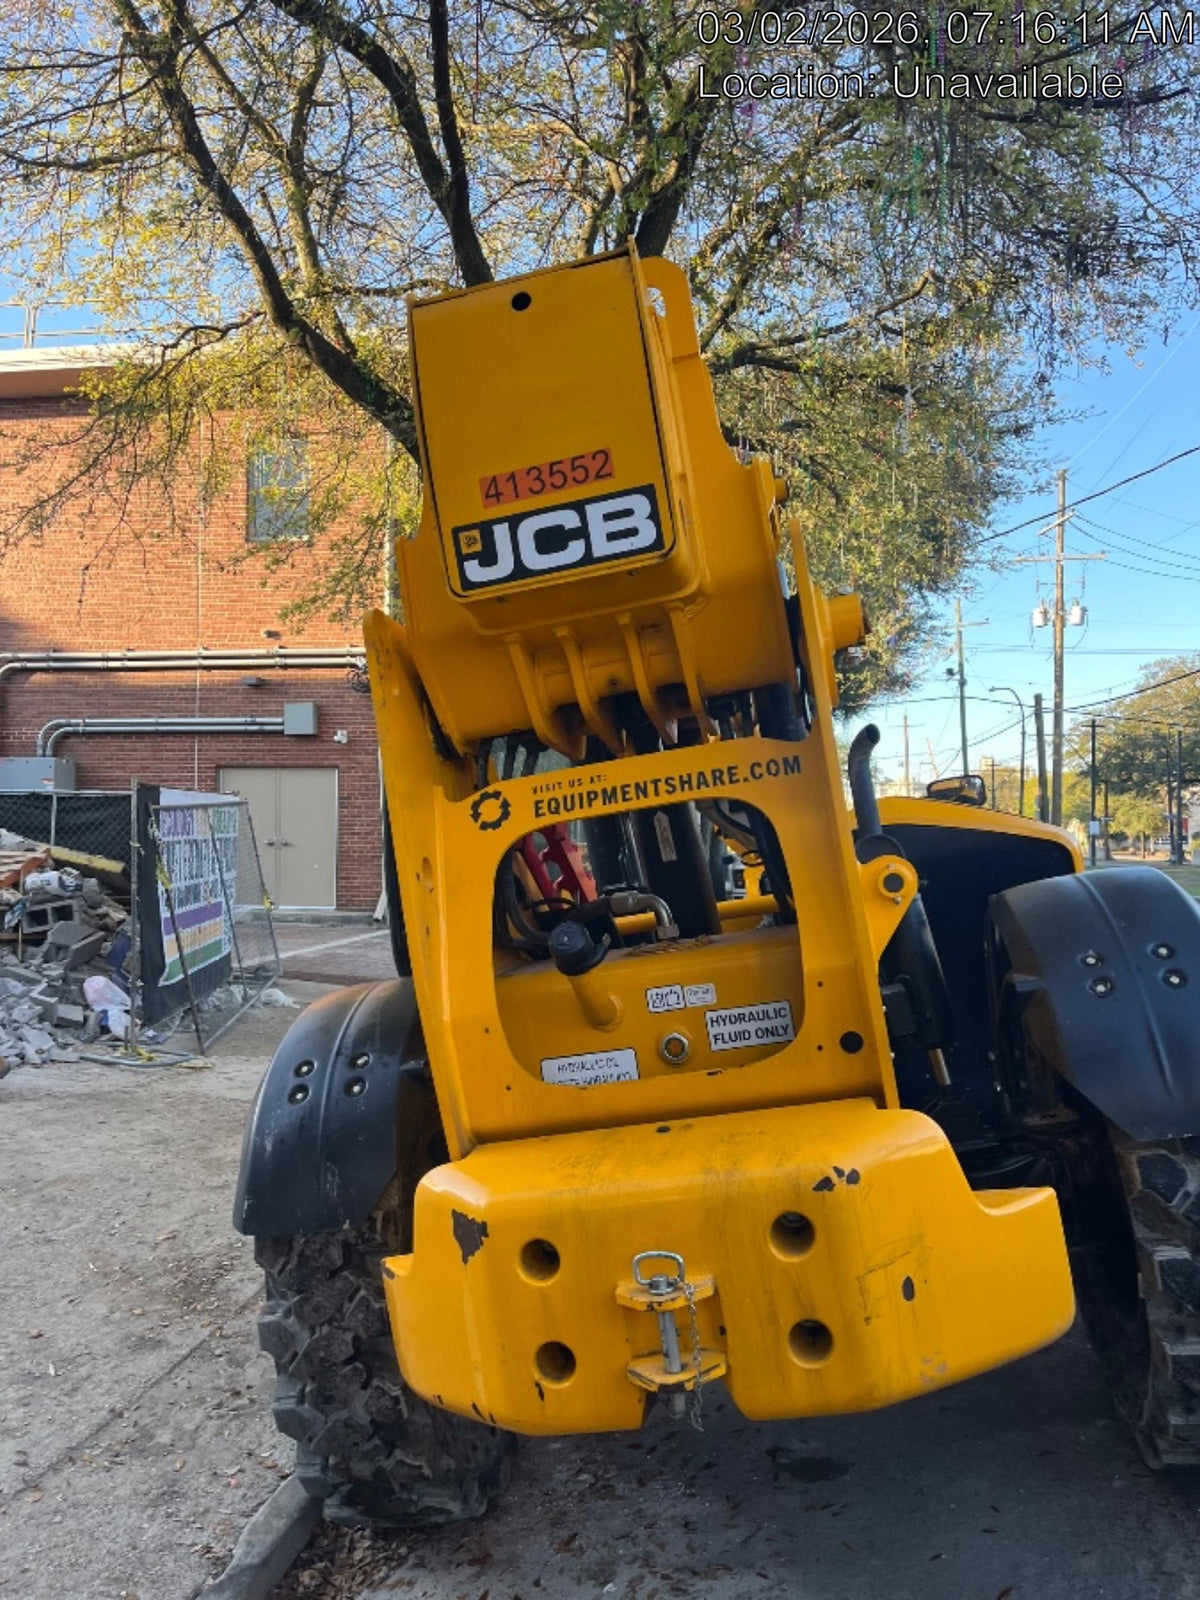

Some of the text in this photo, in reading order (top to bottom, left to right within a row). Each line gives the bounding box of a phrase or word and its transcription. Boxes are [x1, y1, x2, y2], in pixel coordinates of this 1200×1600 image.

[484, 449, 613, 504] 413552
[463, 493, 657, 582] JCB
[532, 774, 608, 795] VISIT US AT:
[534, 755, 803, 818] EQUIPMENTSHARE.COM
[709, 1007, 788, 1028] HYDRAULIC
[712, 1023, 790, 1046] FLUID ONLY
